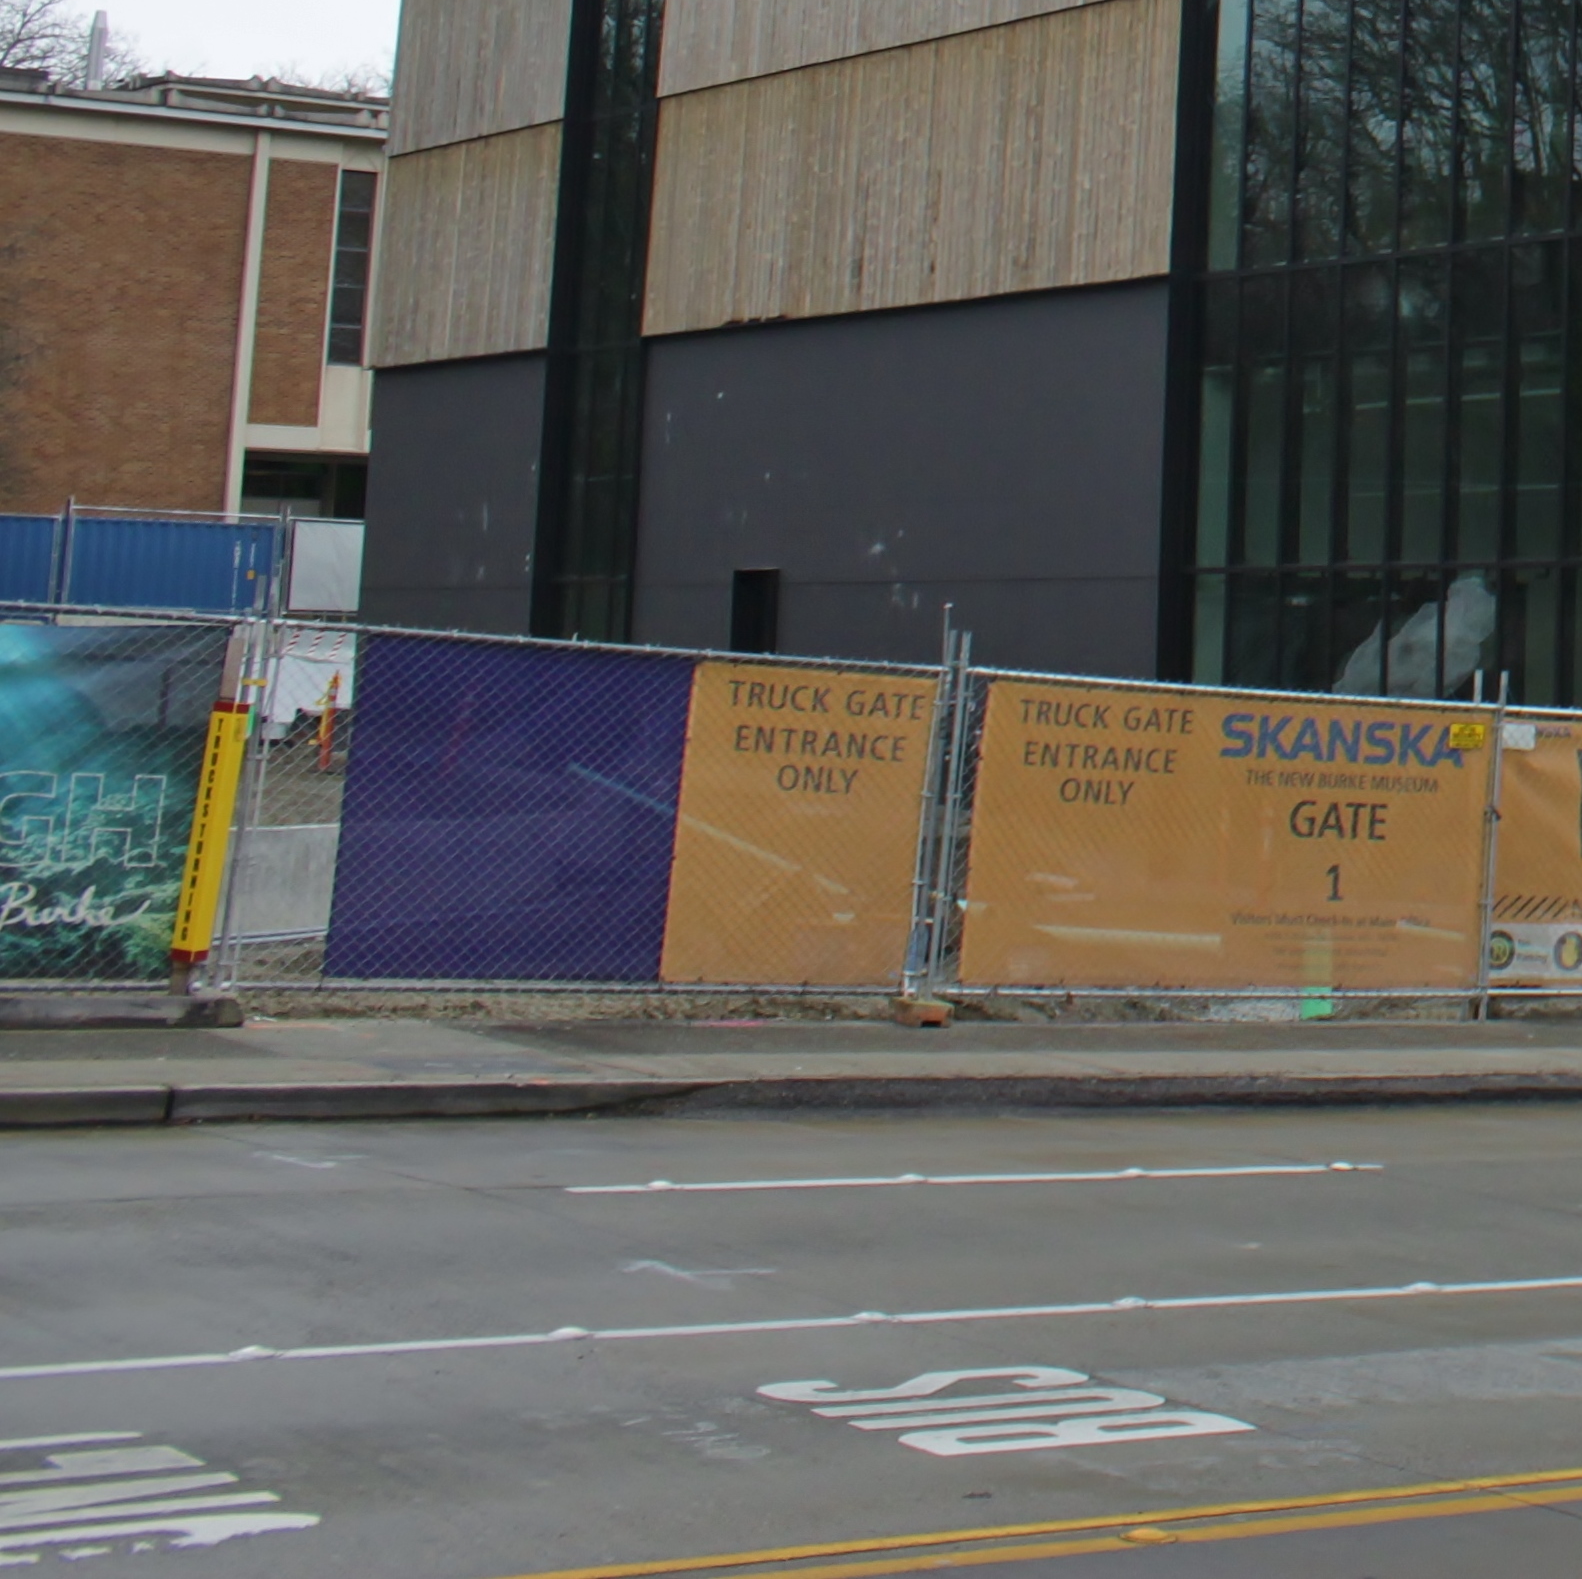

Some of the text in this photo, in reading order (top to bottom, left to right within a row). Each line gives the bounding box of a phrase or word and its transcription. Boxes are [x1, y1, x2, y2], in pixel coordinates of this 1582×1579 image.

[729, 680, 926, 720] TRUCK GATE
[1020, 698, 1195, 735] TRUCK GATE
[734, 725, 908, 762] ENTRANCE
[1023, 741, 1178, 774] ENTRANCE
[1219, 713, 1465, 768] SKANSKA
[777, 764, 859, 794] ONLY
[1059, 777, 1134, 805] ONLY
[1246, 770, 1440, 794] THE NEW BURKE MUSEUM
[1289, 800, 1389, 841] GATE
[1326, 864, 1344, 902] 1
[756, 1365, 1258, 1457] BUS
